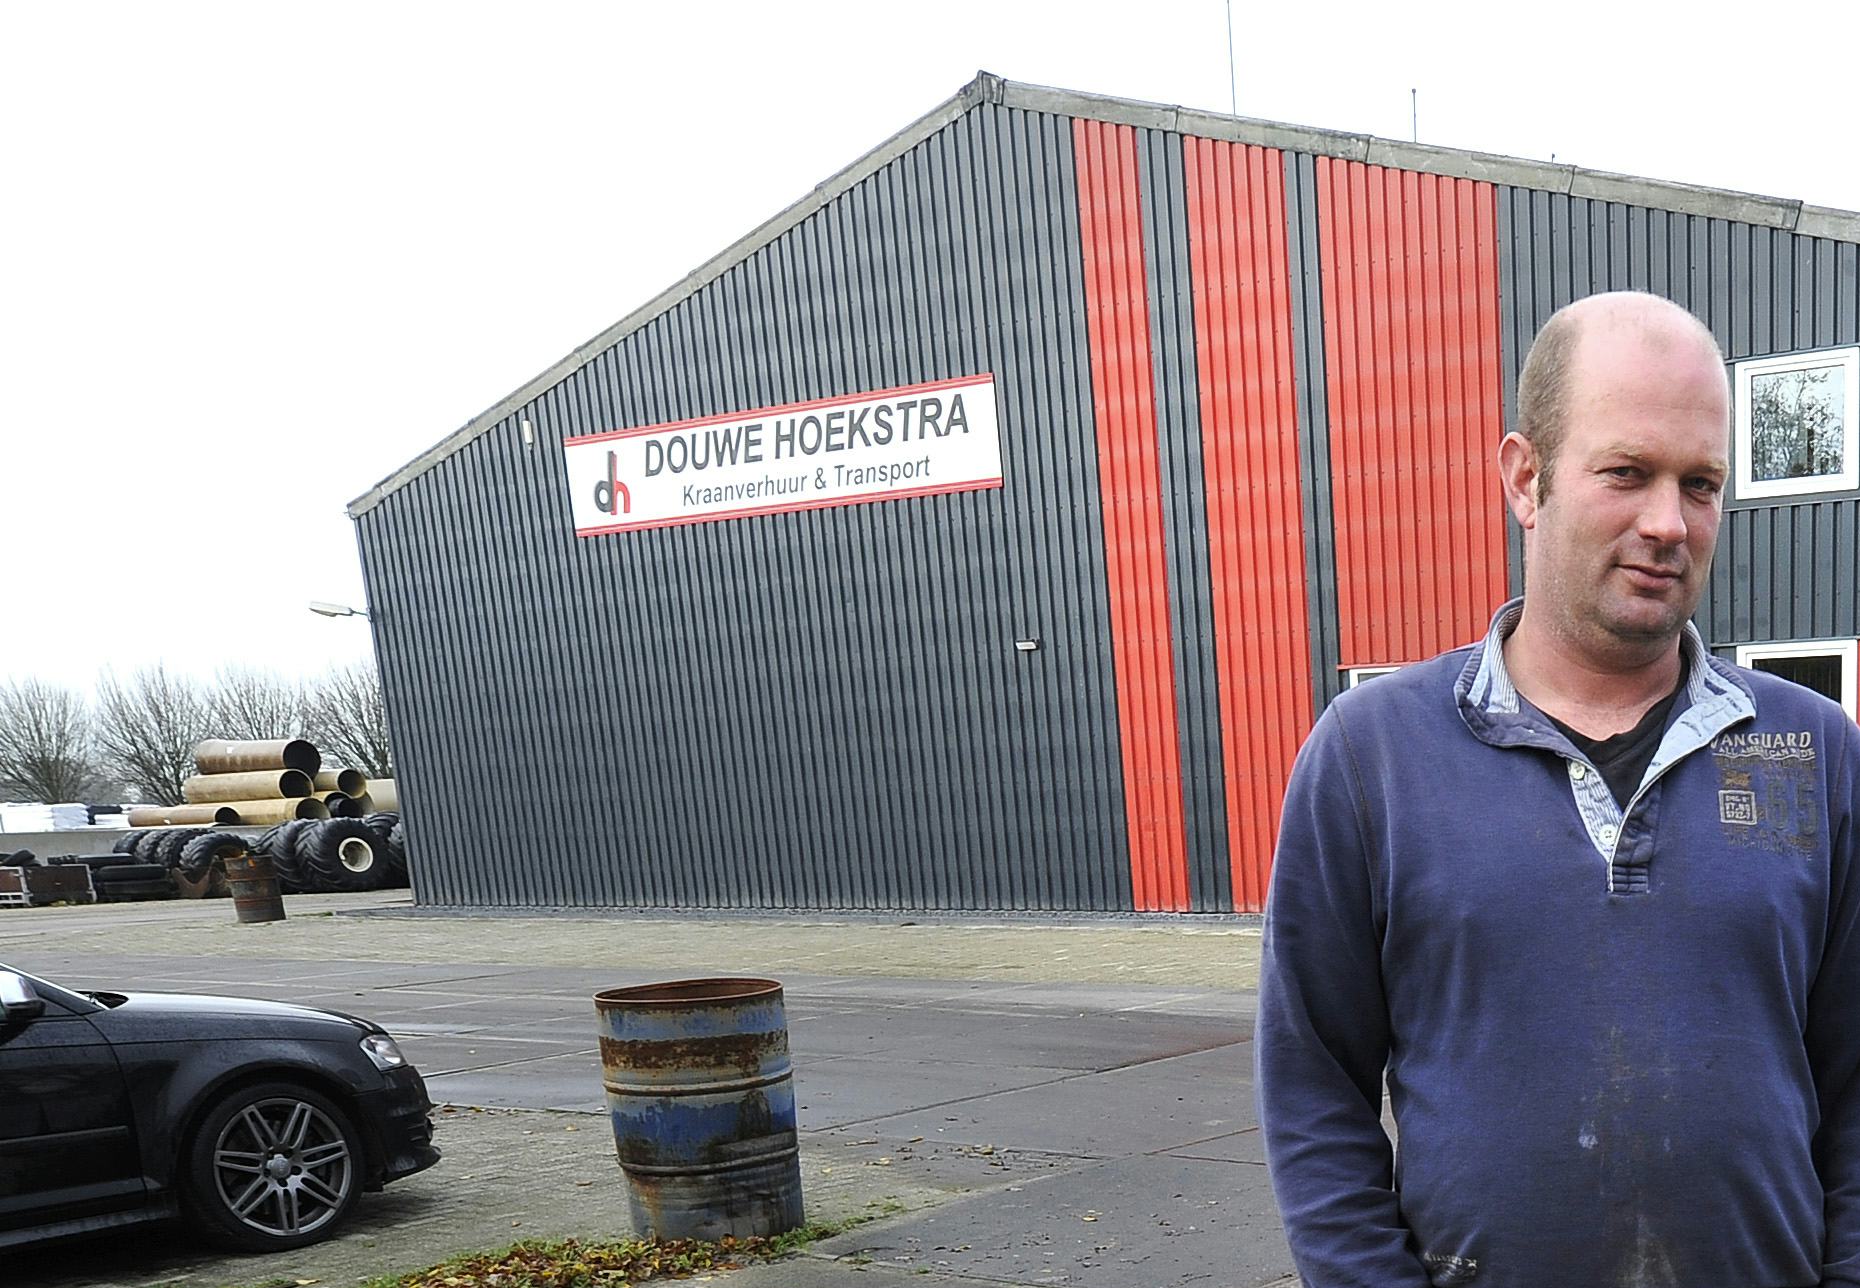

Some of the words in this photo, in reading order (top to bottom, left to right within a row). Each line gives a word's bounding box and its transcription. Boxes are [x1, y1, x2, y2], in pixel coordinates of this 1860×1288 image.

[645, 424, 763, 477] DOUWE
[775, 393, 969, 459] HOEKSTRA
[683, 475, 808, 507] Kraanverhuur
[814, 467, 827, 490] &
[834, 455, 930, 487] Transport
